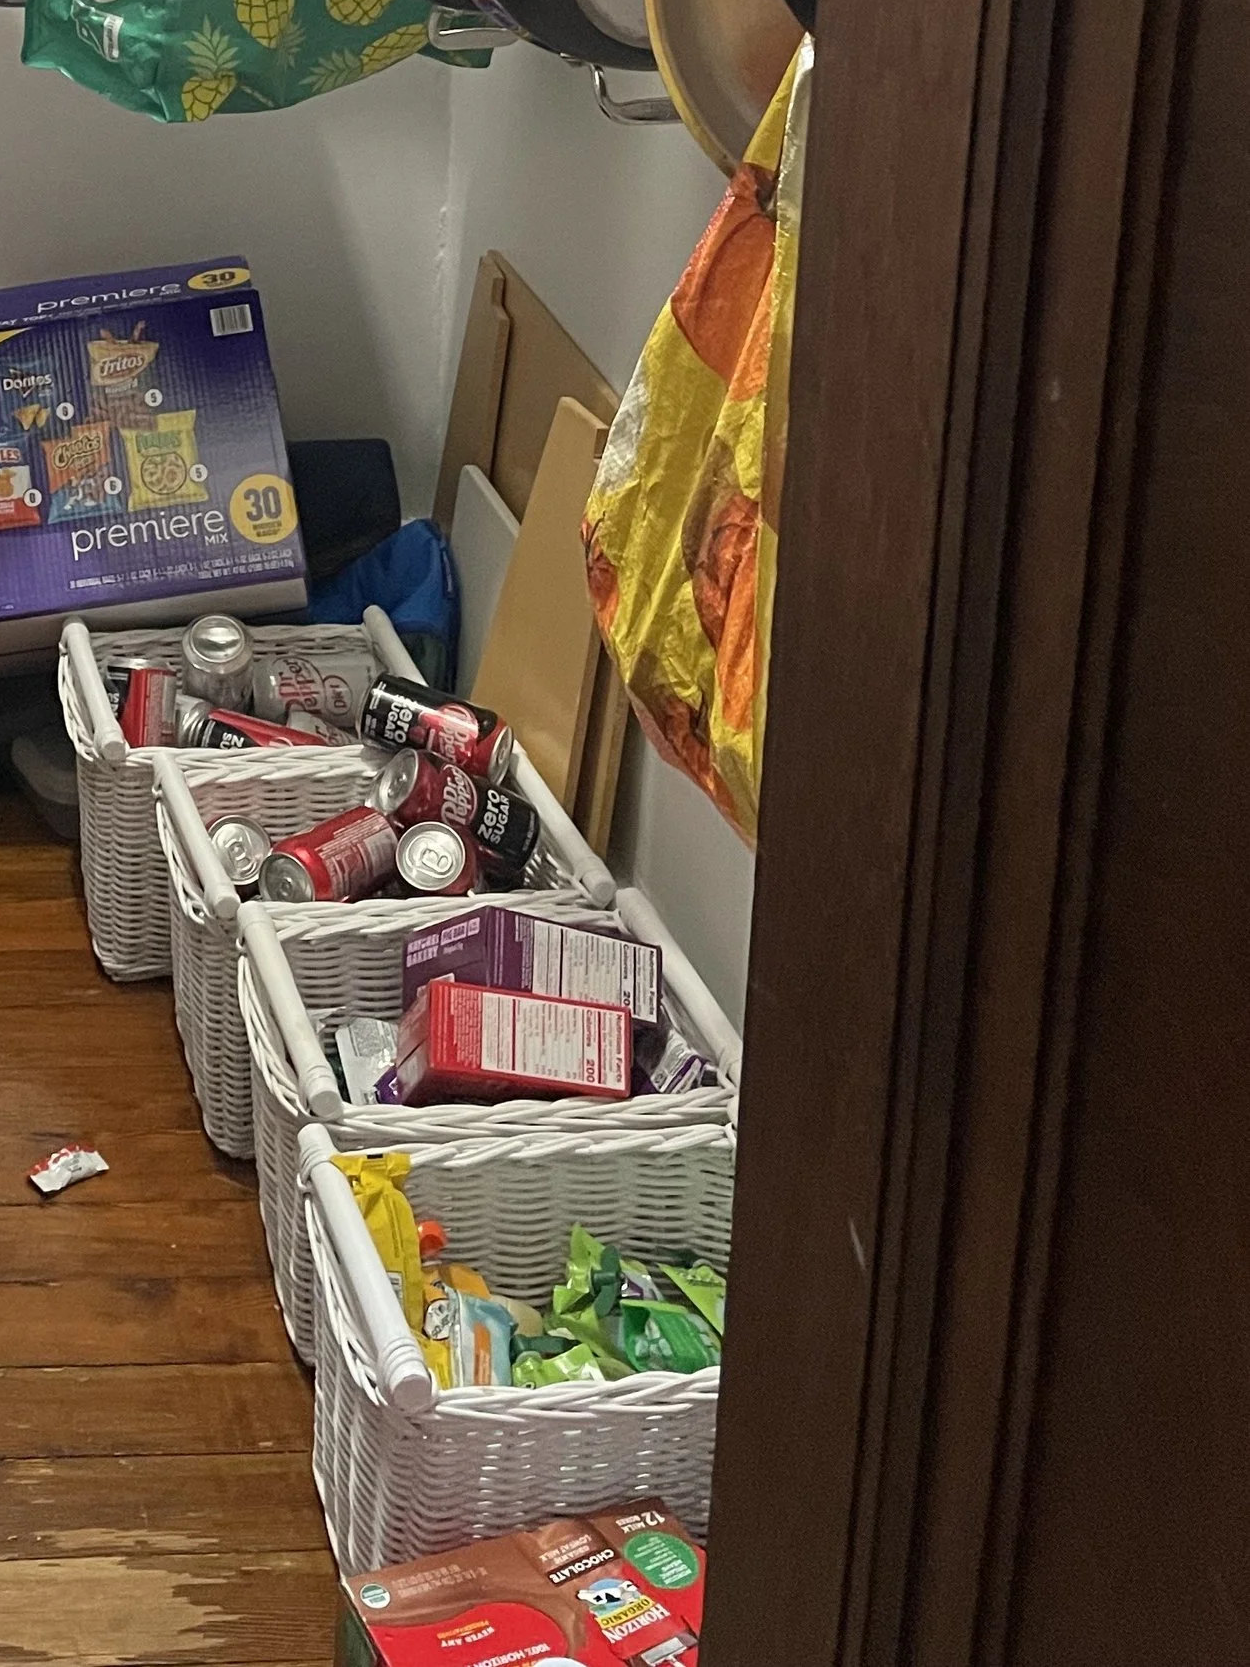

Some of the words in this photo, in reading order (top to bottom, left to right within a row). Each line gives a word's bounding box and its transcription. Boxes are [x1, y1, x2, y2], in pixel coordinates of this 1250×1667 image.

[37, 283, 180, 314] premiere
[201, 270, 236, 285] 30
[2, 373, 53, 391] Doritos
[100, 354, 145, 376] Fritos
[53, 432, 102, 470] Cheetos
[71, 509, 225, 561] premiere
[243, 485, 282, 522] 30
[204, 532, 229, 547] MIX
[441, 766, 471, 826] Pepper
[443, 776, 457, 804] Dr
[477, 789, 501, 840] zero
[490, 794, 510, 844] SUGAR
[585, 1009, 594, 1048] Calories
[616, 1013, 624, 1055] Nutrition
[585, 1058, 595, 1083] 200
[615, 1057, 623, 1083] Facts
[642, 1510, 667, 1533] 12
[549, 1547, 615, 1584] CHOCOLATE
[601, 1596, 652, 1628] ORGANIC
[605, 1604, 671, 1645] HORIZON
